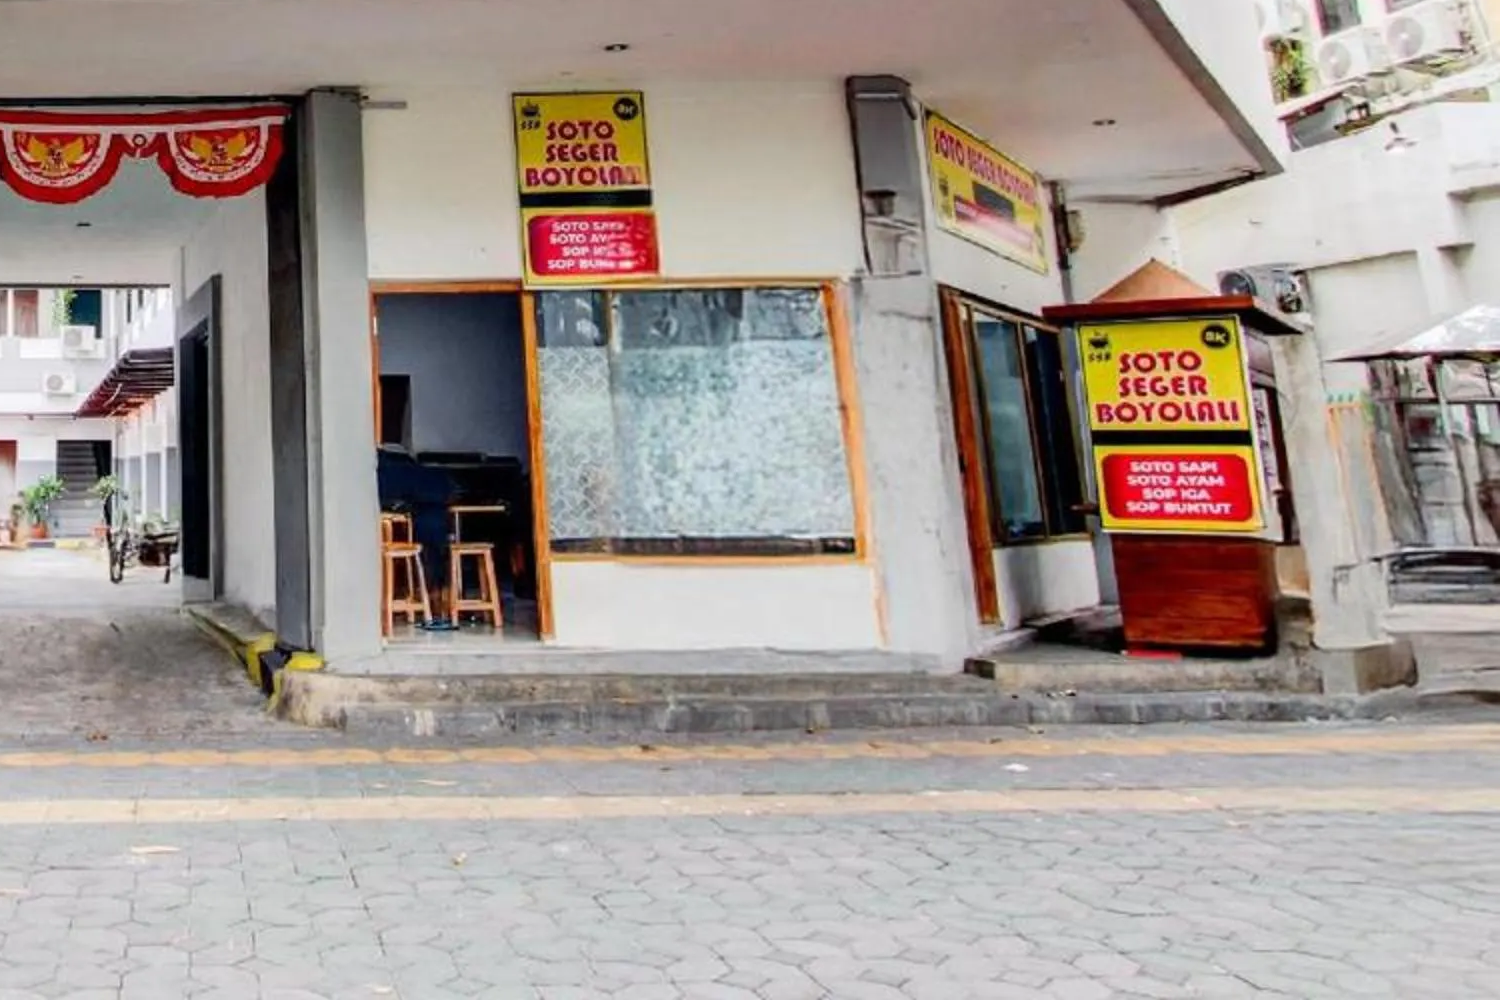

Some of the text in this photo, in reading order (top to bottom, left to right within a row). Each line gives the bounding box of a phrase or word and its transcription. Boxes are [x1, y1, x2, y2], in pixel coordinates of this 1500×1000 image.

[546, 120, 615, 141] SOTO
[546, 142, 619, 163] SEGER
[553, 221, 589, 233] SOTO
[550, 233, 630, 245] SOTO AY
[1119, 350, 1202, 373] SOTO
[1119, 375, 1208, 397] SEGER
[1095, 401, 1240, 423] BOYOLALI
[1130, 461, 1218, 473] SOTO SAPI
[1126, 475, 1225, 486] SOTO AYAM
[1142, 488, 1211, 499] SOP IGA
[1126, 501, 1160, 512] SOP
